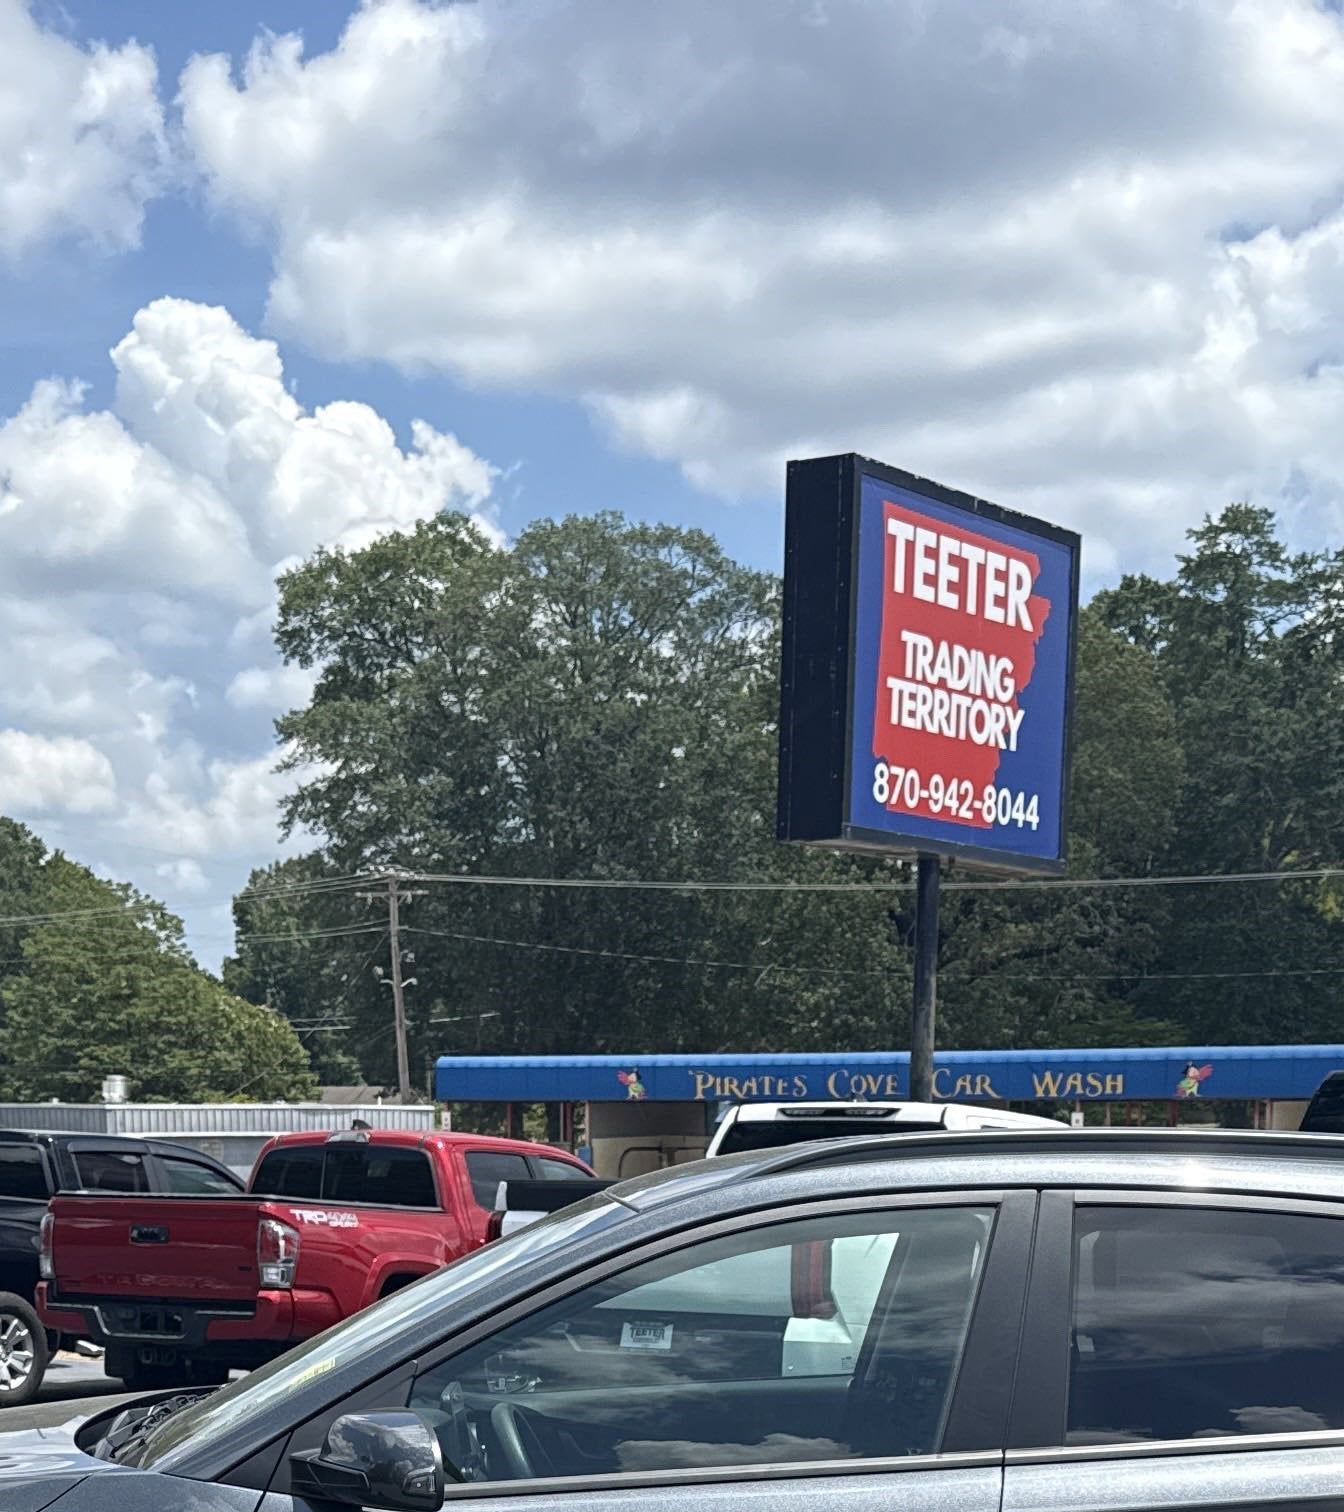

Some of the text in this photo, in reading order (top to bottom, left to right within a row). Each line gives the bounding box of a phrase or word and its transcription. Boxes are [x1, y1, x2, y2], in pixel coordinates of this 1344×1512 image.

[887, 517, 1034, 632] TEETER
[901, 630, 1015, 703] TRADING
[886, 676, 1025, 752] TERRITORY
[872, 762, 1039, 831] 870-942-8044
[1032, 1070, 1124, 1098] WASH
